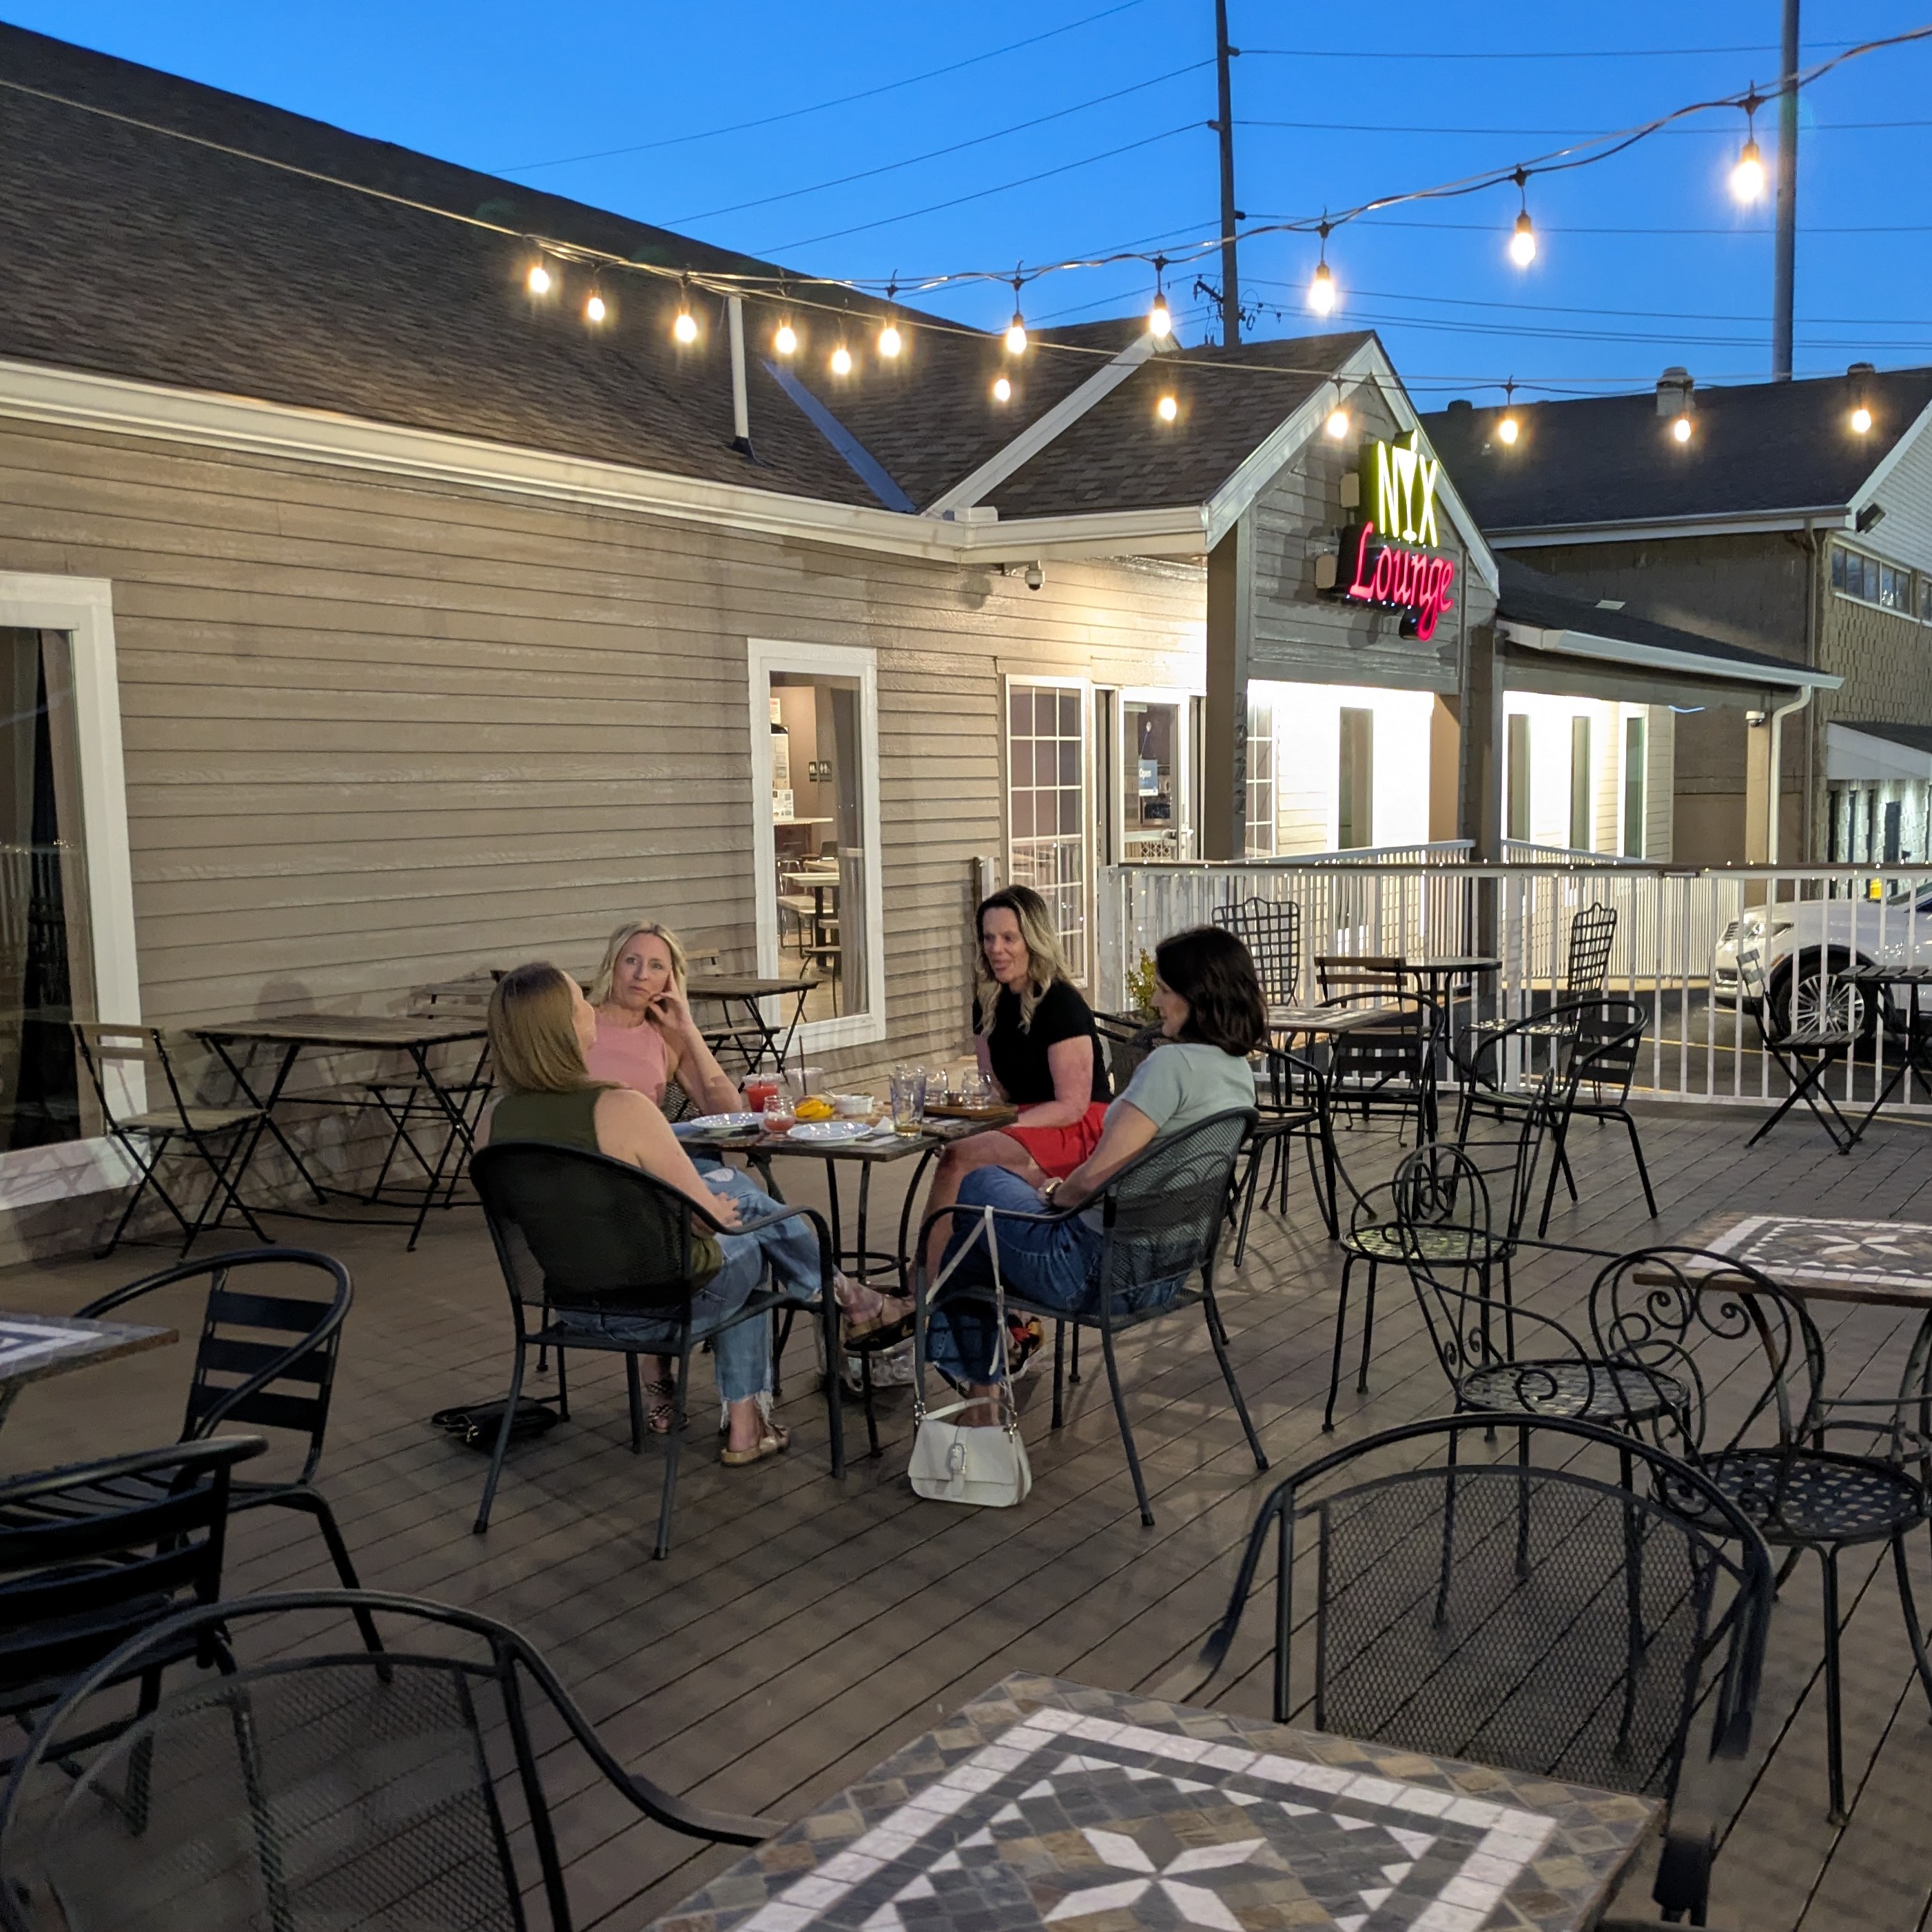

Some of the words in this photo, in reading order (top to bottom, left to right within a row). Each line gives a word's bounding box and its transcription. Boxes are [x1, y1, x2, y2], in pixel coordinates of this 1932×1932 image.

[1378, 431, 1439, 548] NYX
[1349, 521, 1455, 641] Lounge
[1139, 768, 1151, 779] Open
